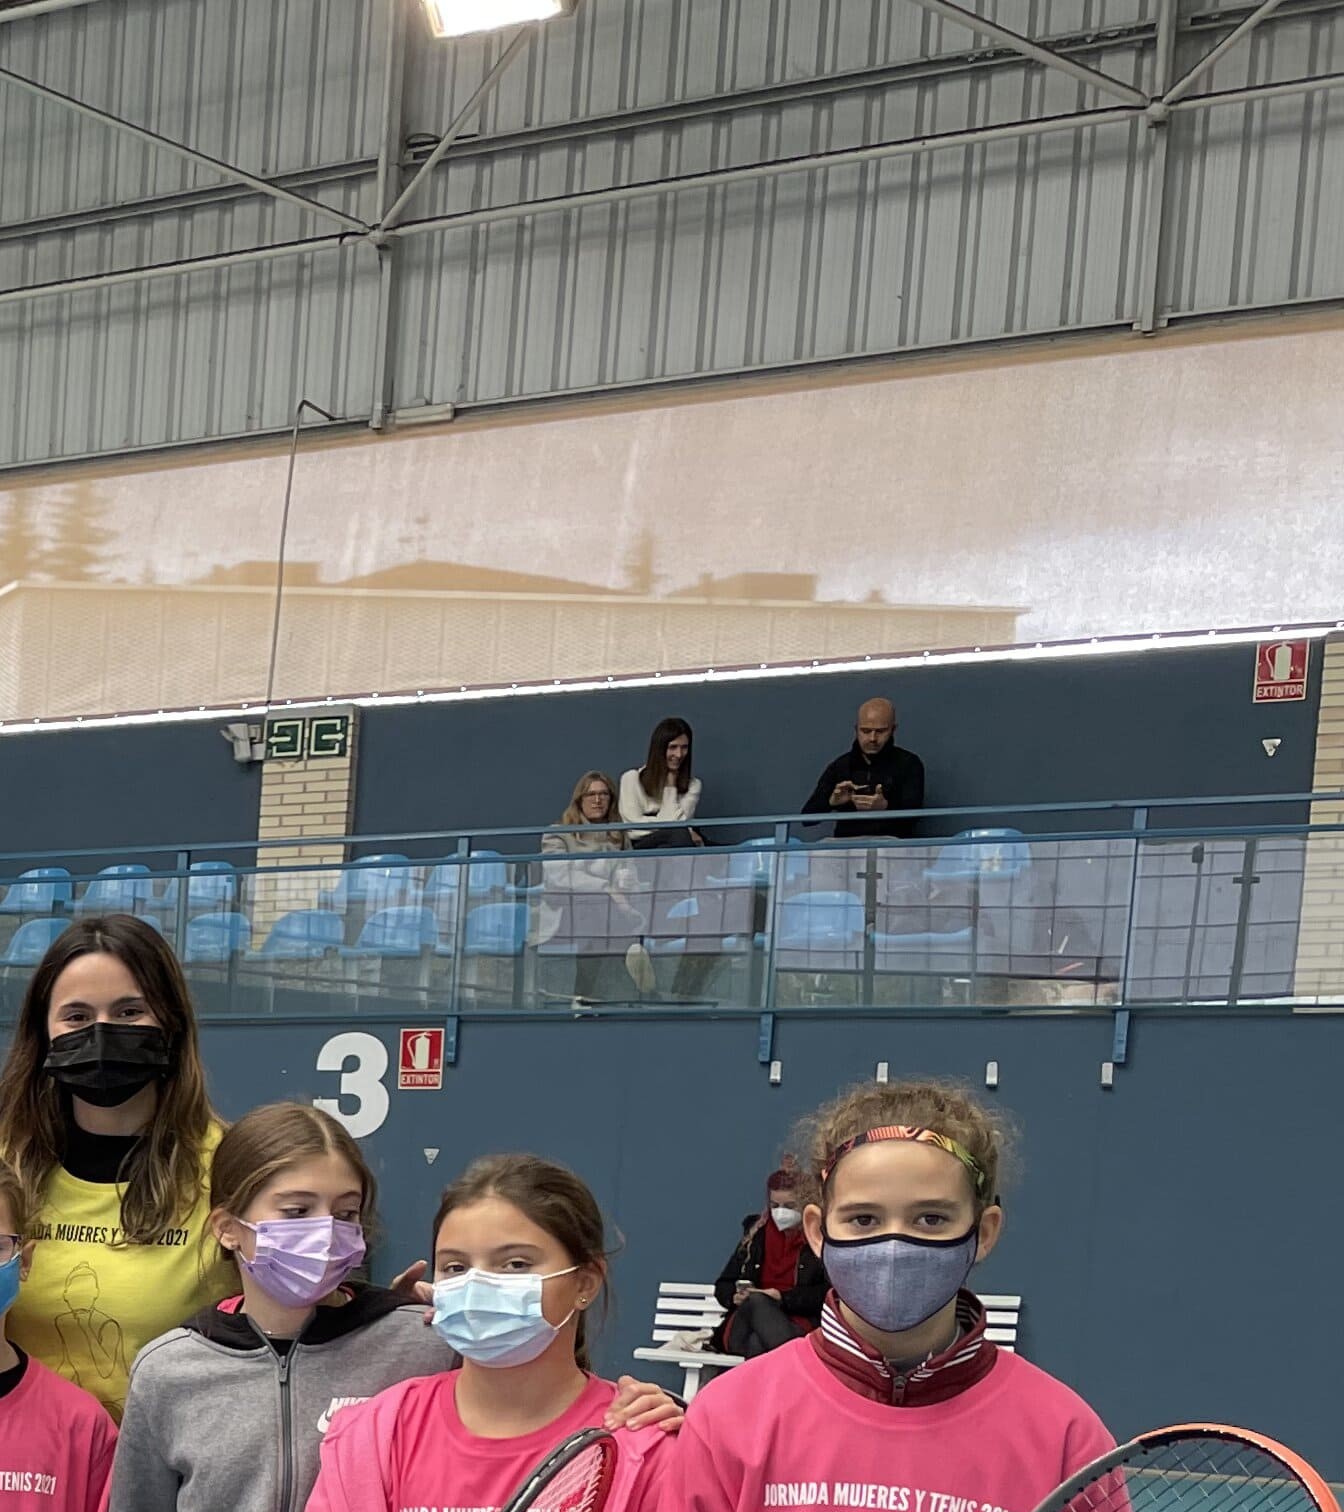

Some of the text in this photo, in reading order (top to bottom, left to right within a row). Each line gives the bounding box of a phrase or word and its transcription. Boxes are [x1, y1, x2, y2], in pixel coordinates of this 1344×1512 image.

[1257, 684, 1303, 698] EXTINTOR
[313, 1032, 389, 1139] 3
[401, 1073, 440, 1085] EXTINTOR
[55, 1223, 108, 1244] MUJERES
[111, 1227, 120, 1243] Y
[34, 1473, 57, 1495] 2021
[764, 1482, 828, 1507] JORNADA
[833, 1483, 910, 1512] MUJERES
[915, 1489, 927, 1512] Y
